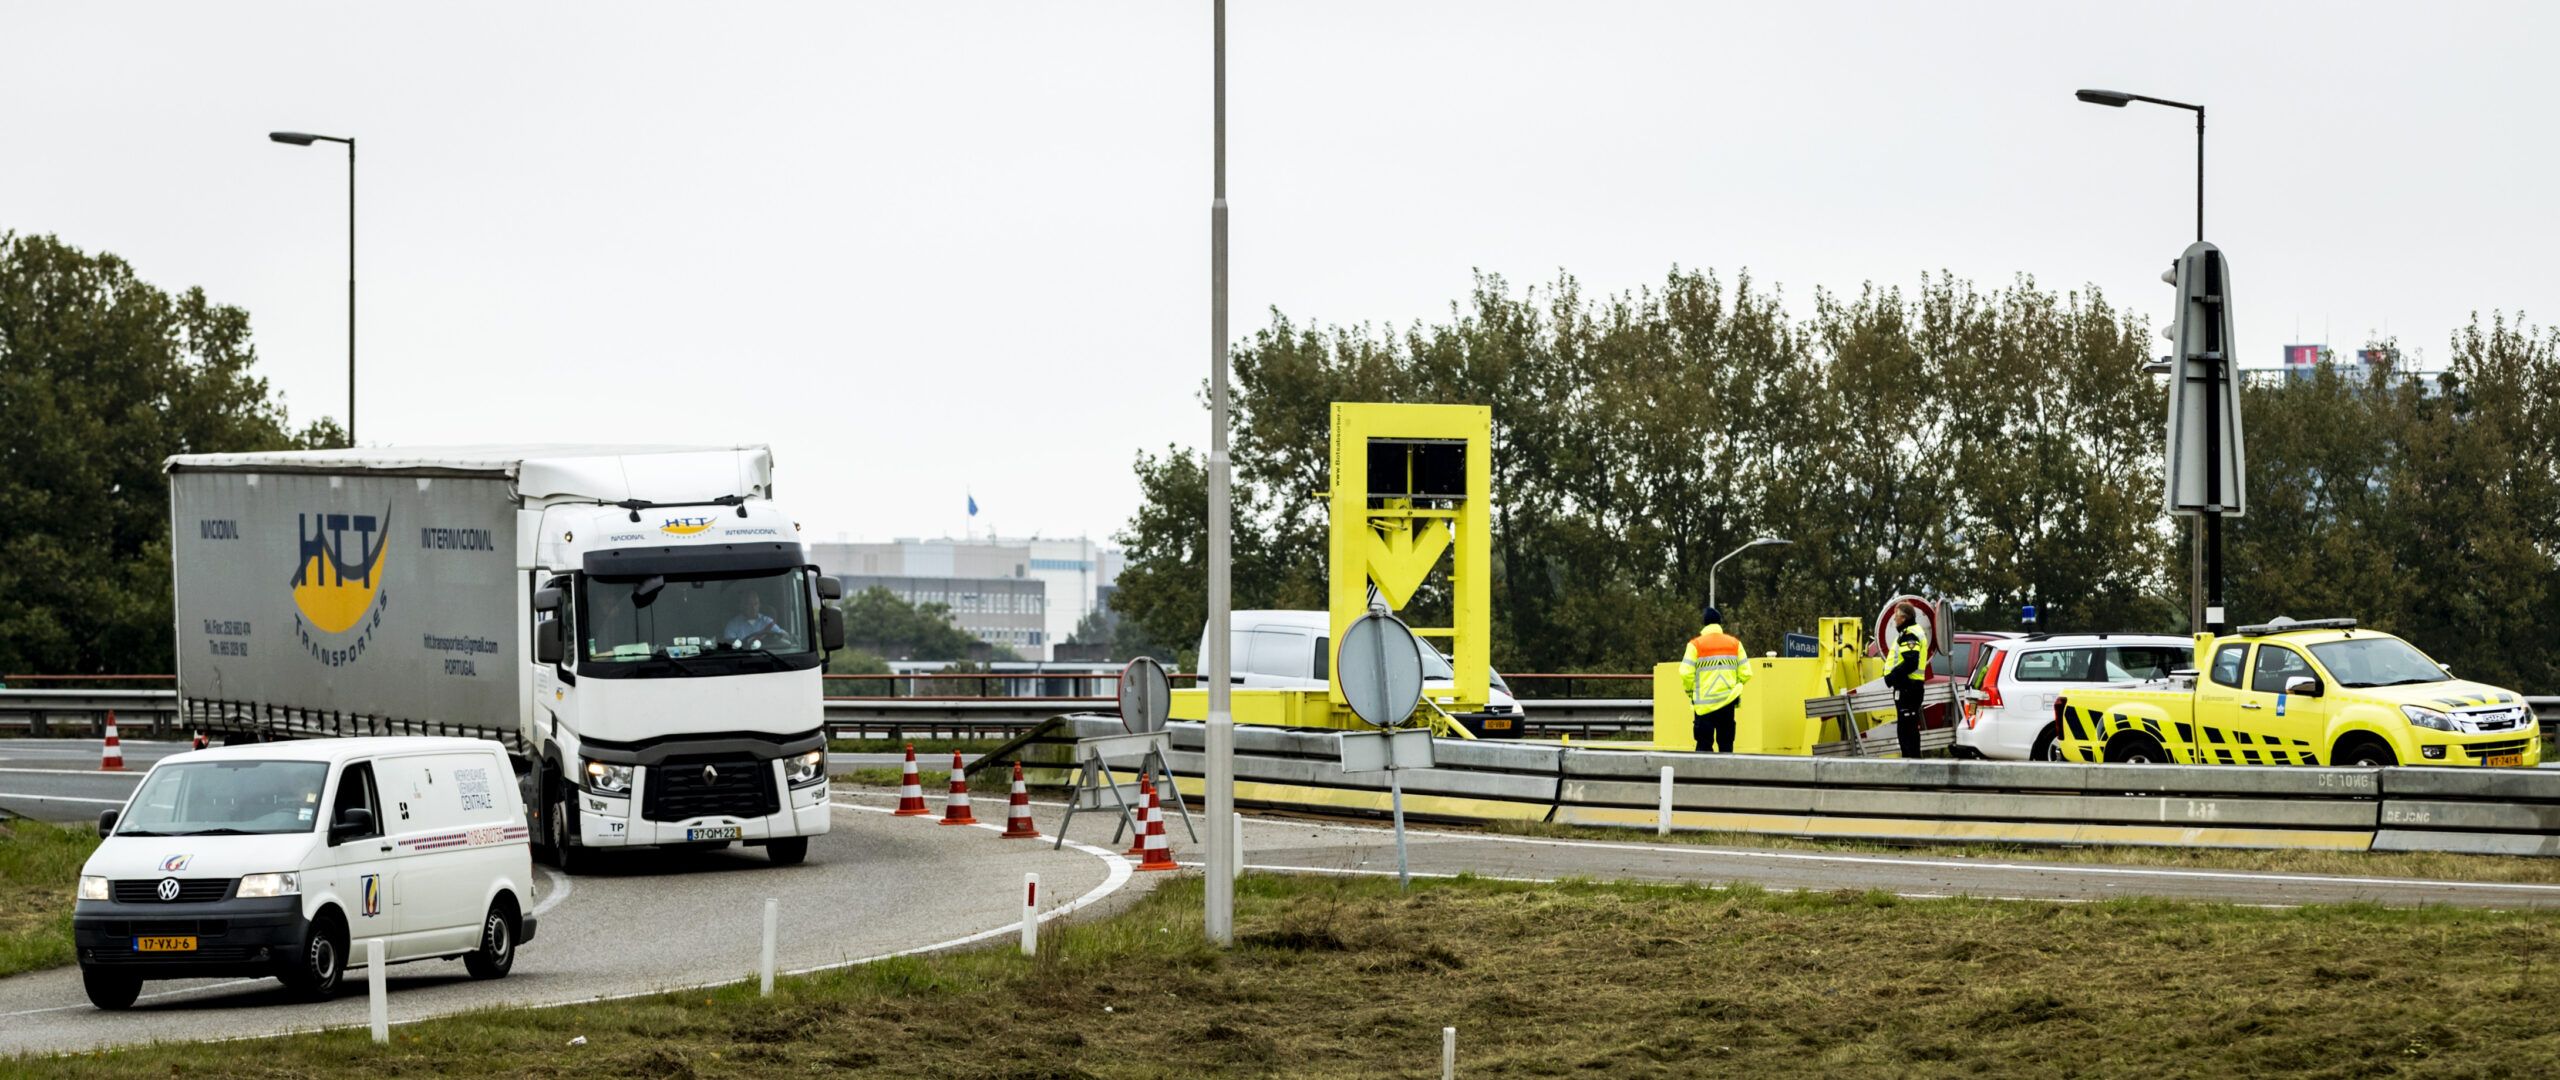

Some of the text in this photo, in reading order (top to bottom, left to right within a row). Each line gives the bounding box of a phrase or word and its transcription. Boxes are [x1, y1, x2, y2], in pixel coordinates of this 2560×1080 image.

[201, 520, 239, 539] NACIONAL
[665, 517, 708, 528] HTT
[421, 527, 494, 551] INTERNACIONAL
[611, 534, 646, 542] NACIONAL
[725, 528, 778, 536] INTERNACIONAL
[299, 513, 377, 589] HTT
[295, 589, 387, 667] TRANSPORTES
[1789, 639, 1818, 653] Kanaal
[445, 659, 477, 676] PORTUGAL
[2318, 773, 2333, 787] DE
[461, 793, 492, 811] CENTRALE
[2386, 810, 2431, 823] DE JONG
[610, 823, 624, 832] TP
[143, 938, 190, 950] 17-VXJ-6
